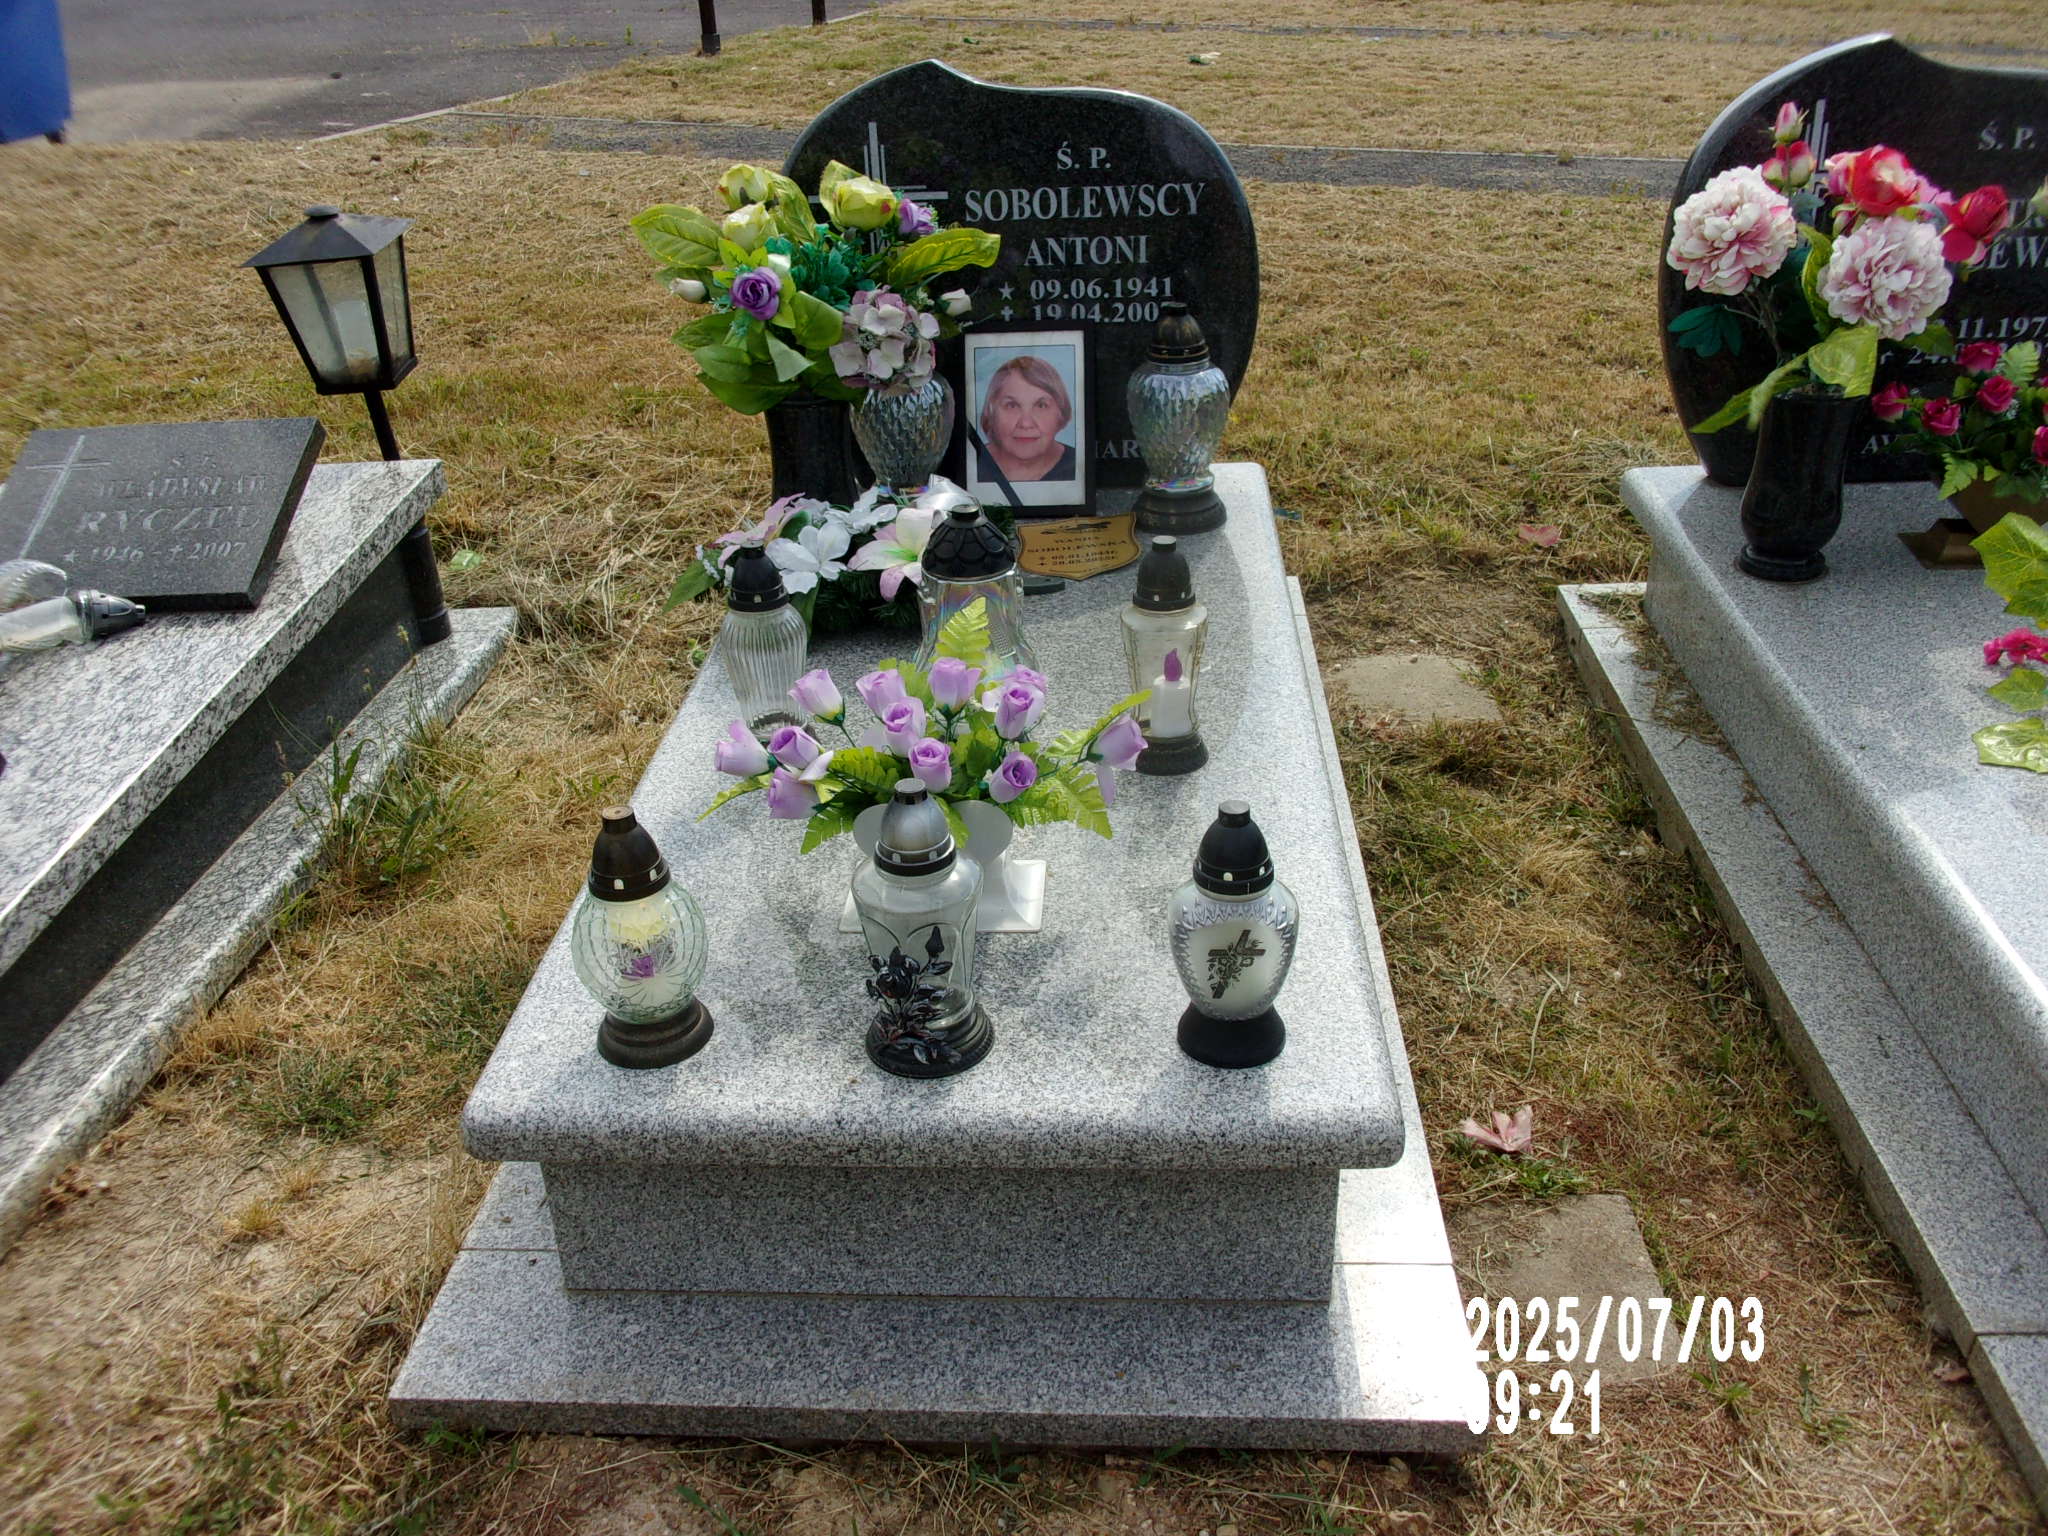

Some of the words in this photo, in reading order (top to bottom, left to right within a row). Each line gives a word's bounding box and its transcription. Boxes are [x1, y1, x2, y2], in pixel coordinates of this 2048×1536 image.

[1089, 147, 1112, 170] P.
[965, 182, 1206, 222] SOBOLEWSCY
[1023, 235, 1150, 267] ANTONI
[1029, 276, 1173, 300] 09.06.1941
[1032, 301, 1161, 324] 1904.200
